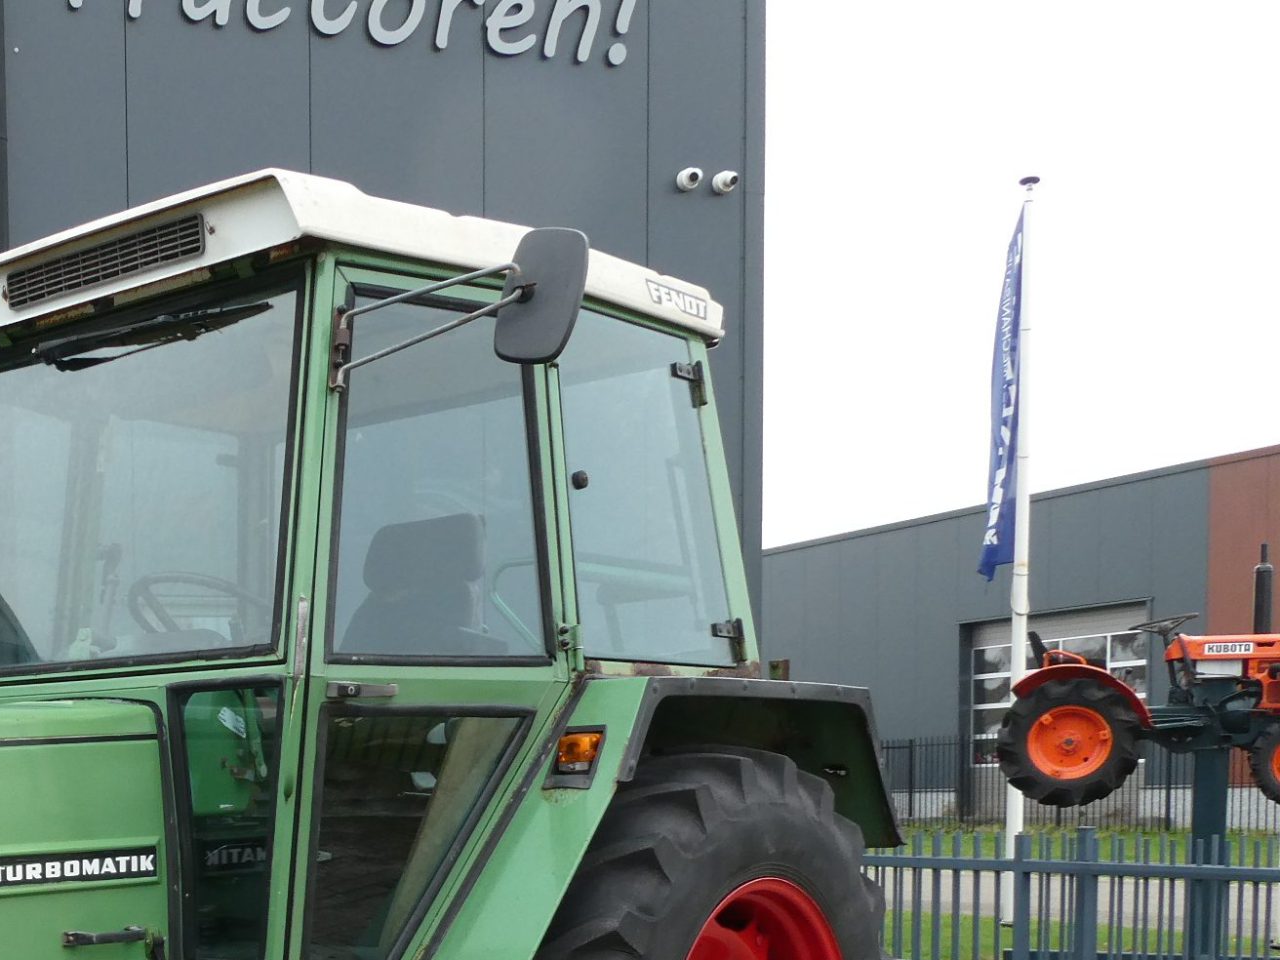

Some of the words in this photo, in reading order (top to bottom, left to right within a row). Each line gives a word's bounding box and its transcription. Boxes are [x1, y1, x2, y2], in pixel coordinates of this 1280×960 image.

[68, 0, 637, 65] oren!
[645, 278, 707, 320] FENDT
[1207, 643, 1251, 653] KUBOTA
